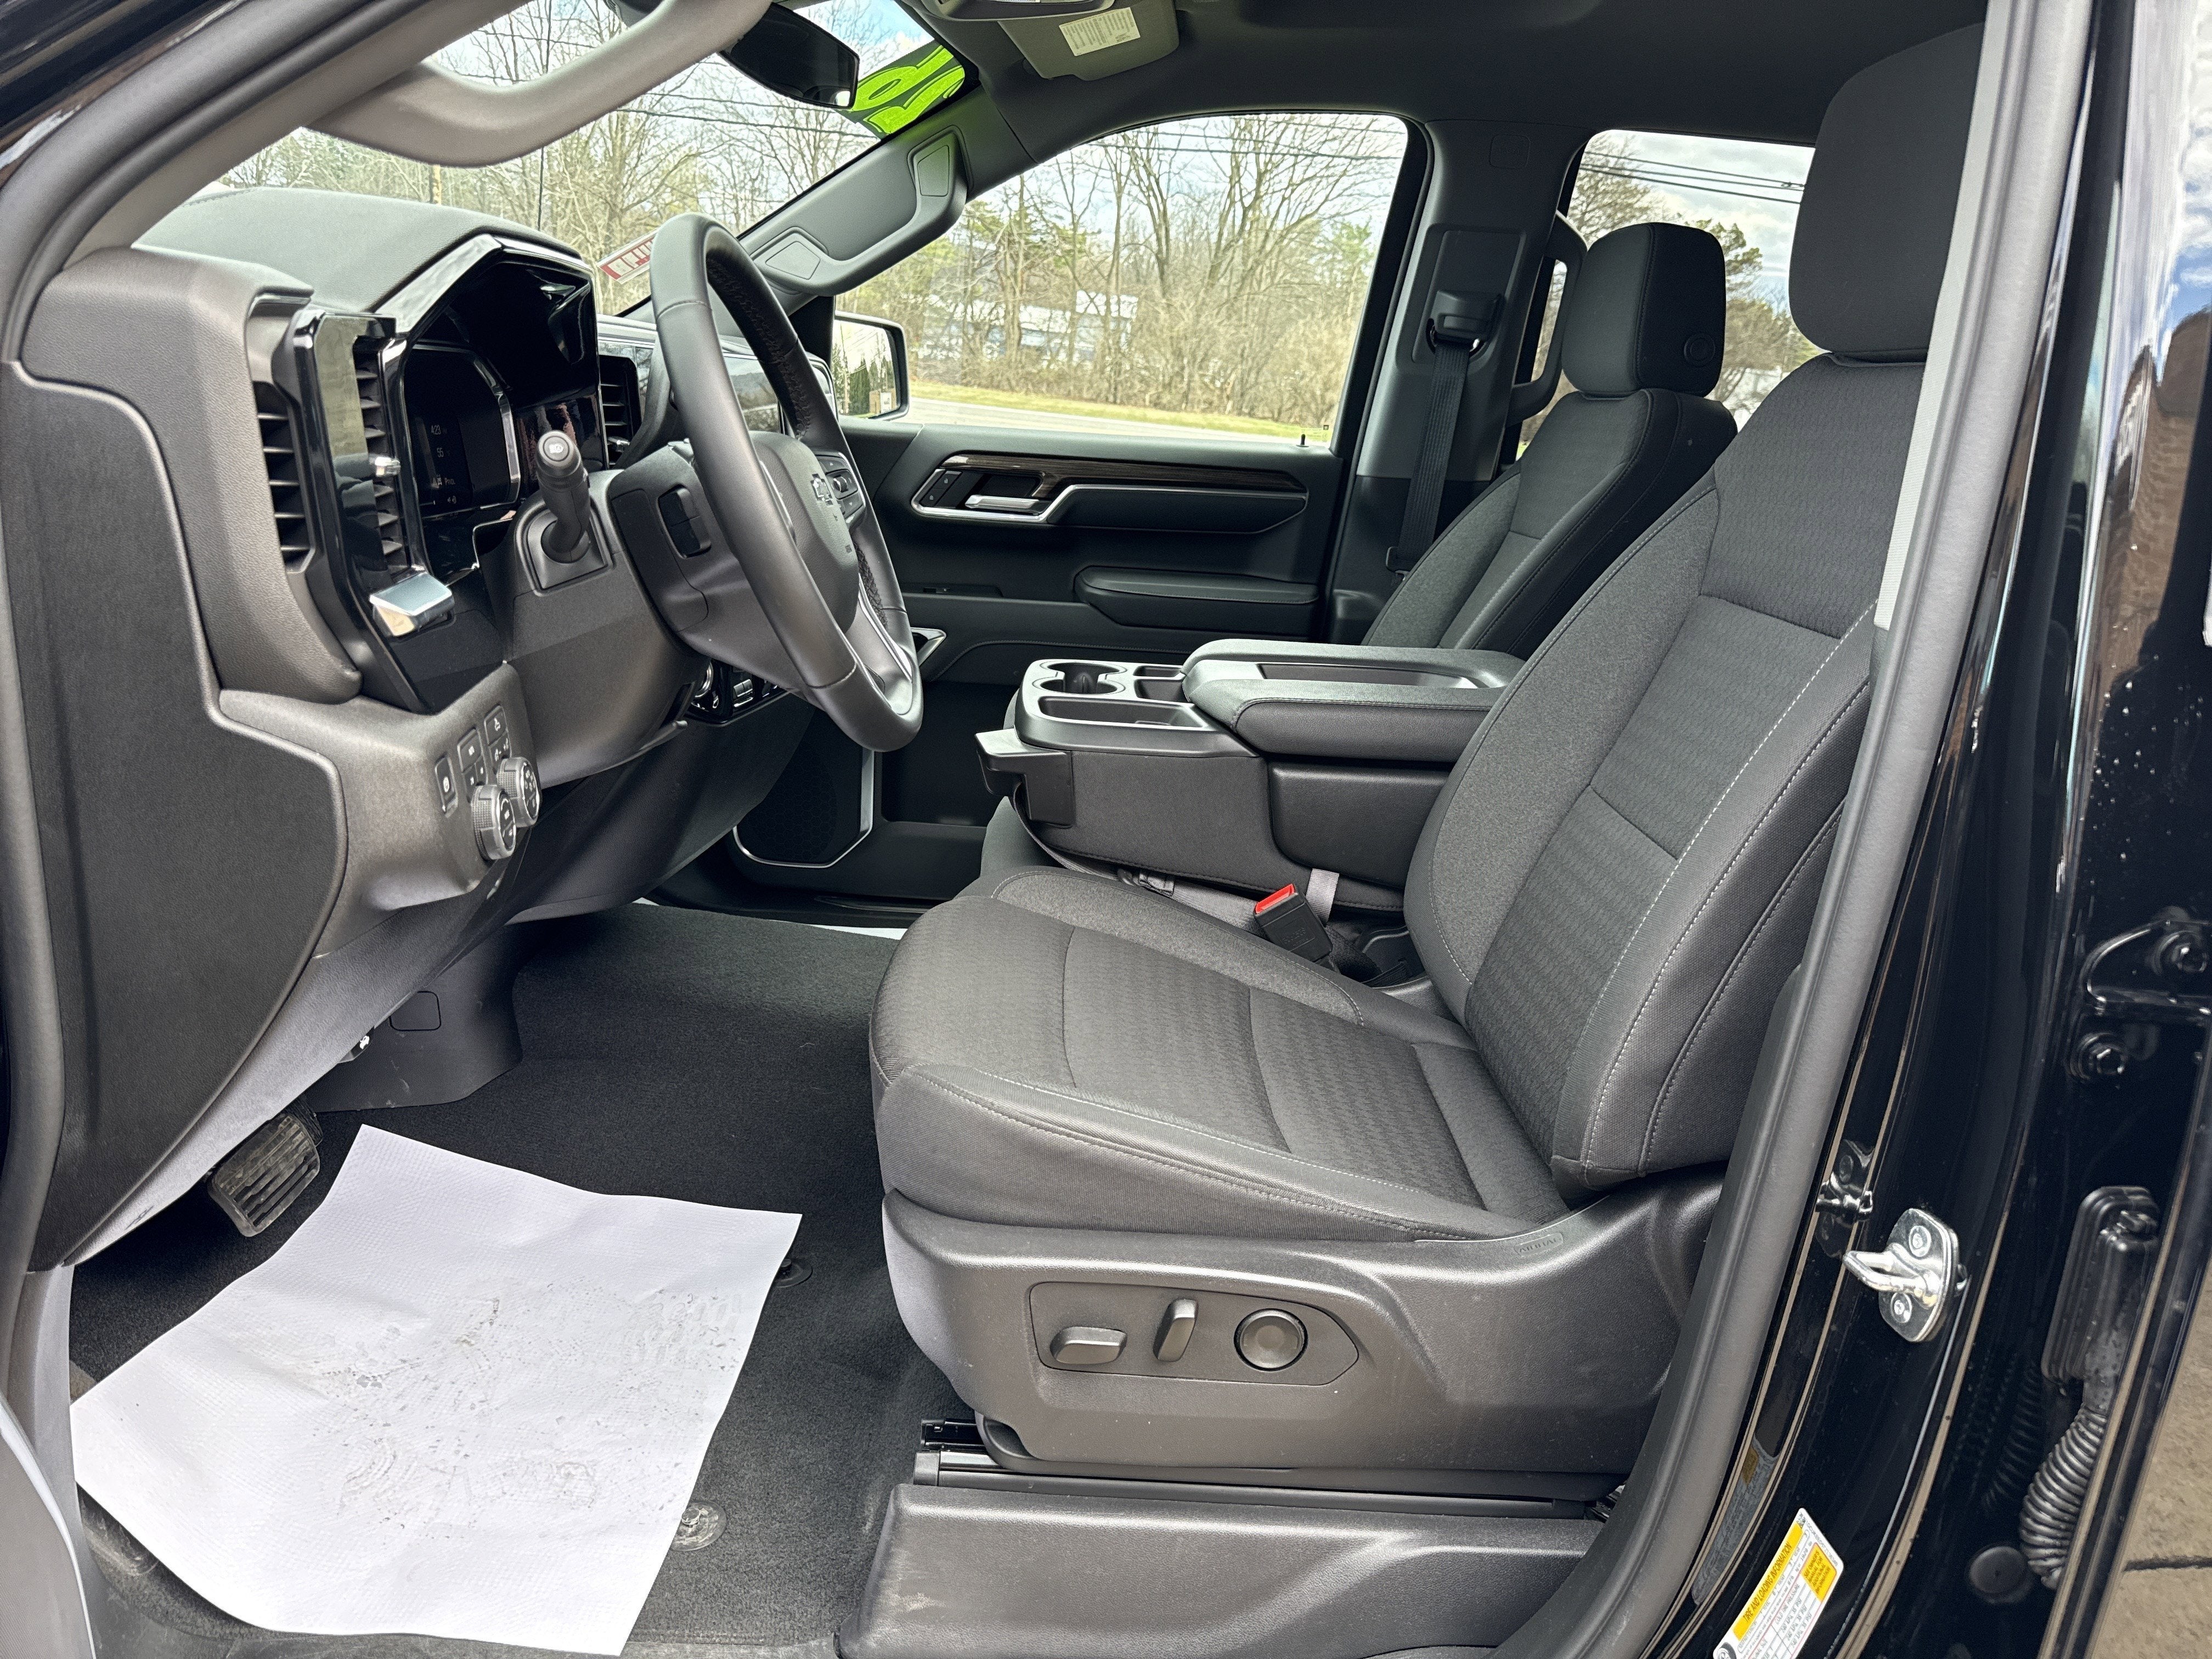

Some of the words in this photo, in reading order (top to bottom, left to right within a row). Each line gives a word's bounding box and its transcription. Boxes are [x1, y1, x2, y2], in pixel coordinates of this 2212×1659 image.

[1743, 1609, 1753, 1623] TIRE
[1750, 1598, 1759, 1611] AND
[1757, 1576, 1773, 1601] LOADING
[1769, 1544, 1792, 1578] INFORMATION
[1786, 1584, 1799, 1604] PRESSURE
